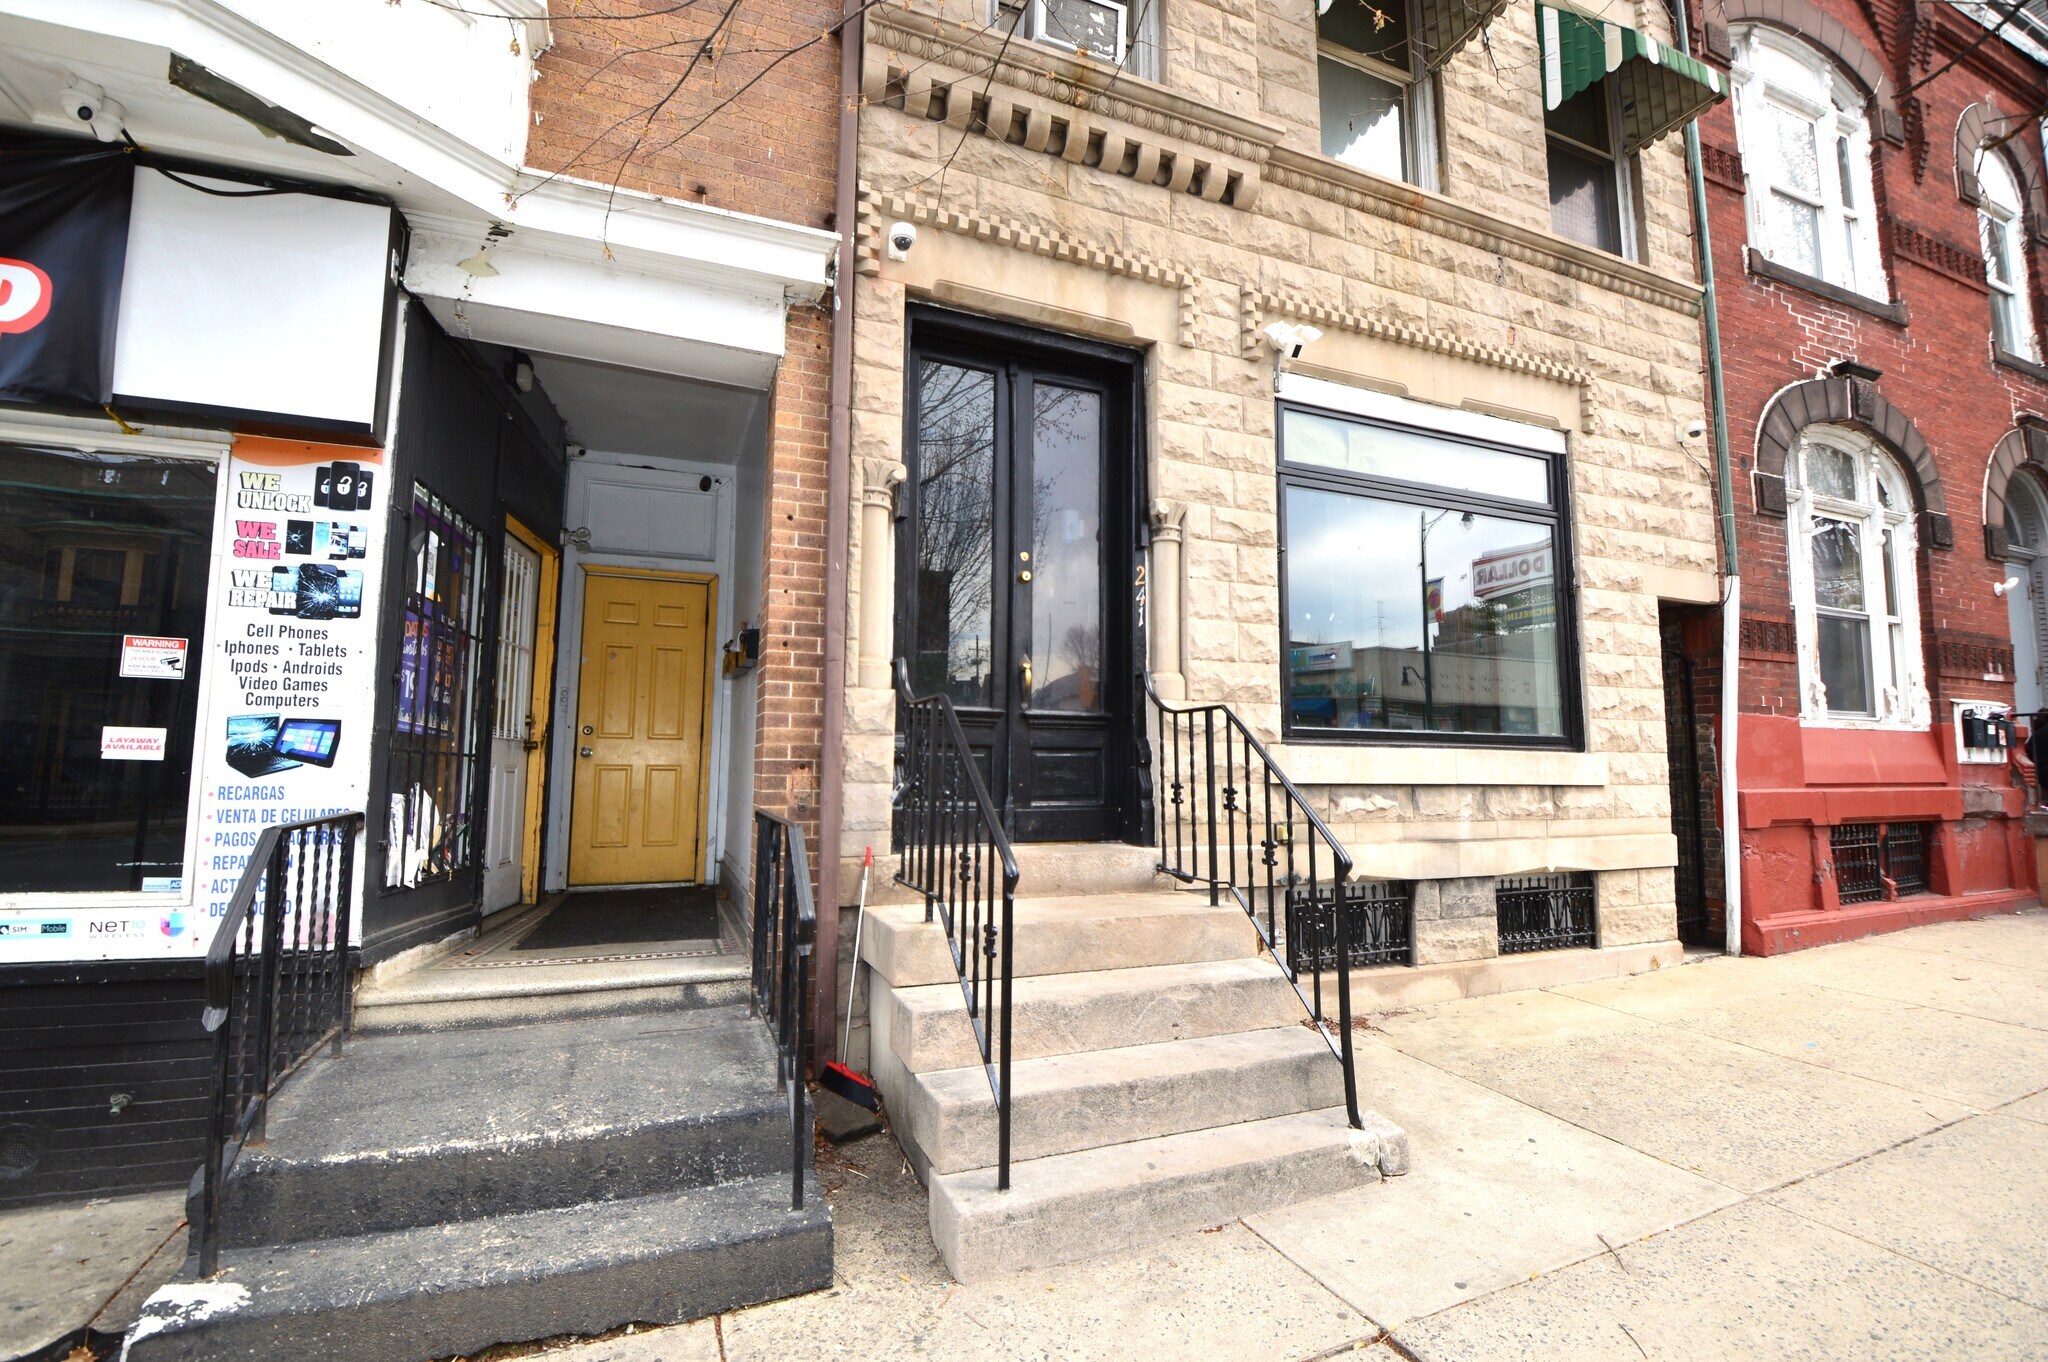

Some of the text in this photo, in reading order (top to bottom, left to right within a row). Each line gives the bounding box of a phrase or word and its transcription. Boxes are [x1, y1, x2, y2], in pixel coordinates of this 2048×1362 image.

[240, 471, 281, 492] WE
[238, 490, 311, 513] UNLOCK
[236, 520, 276, 540] WE
[233, 539, 281, 560] SALE
[231, 569, 273, 588] WE
[229, 588, 297, 609] REPAIR
[1135, 565, 1146, 627] 241
[247, 623, 329, 640] Cell Phones
[405, 621, 429, 637] DATS
[132, 638, 179, 648] WARNING
[224, 640, 347, 657] Iphones Tablets
[230, 659, 343, 675] Ipods Androids
[239, 676, 328, 692] Video Games
[245, 692, 319, 709] Computers
[217, 785, 285, 800] RECARGAS
[216, 808, 350, 823] VENTA DE CELULA
[214, 832, 256, 847] PAGOS
